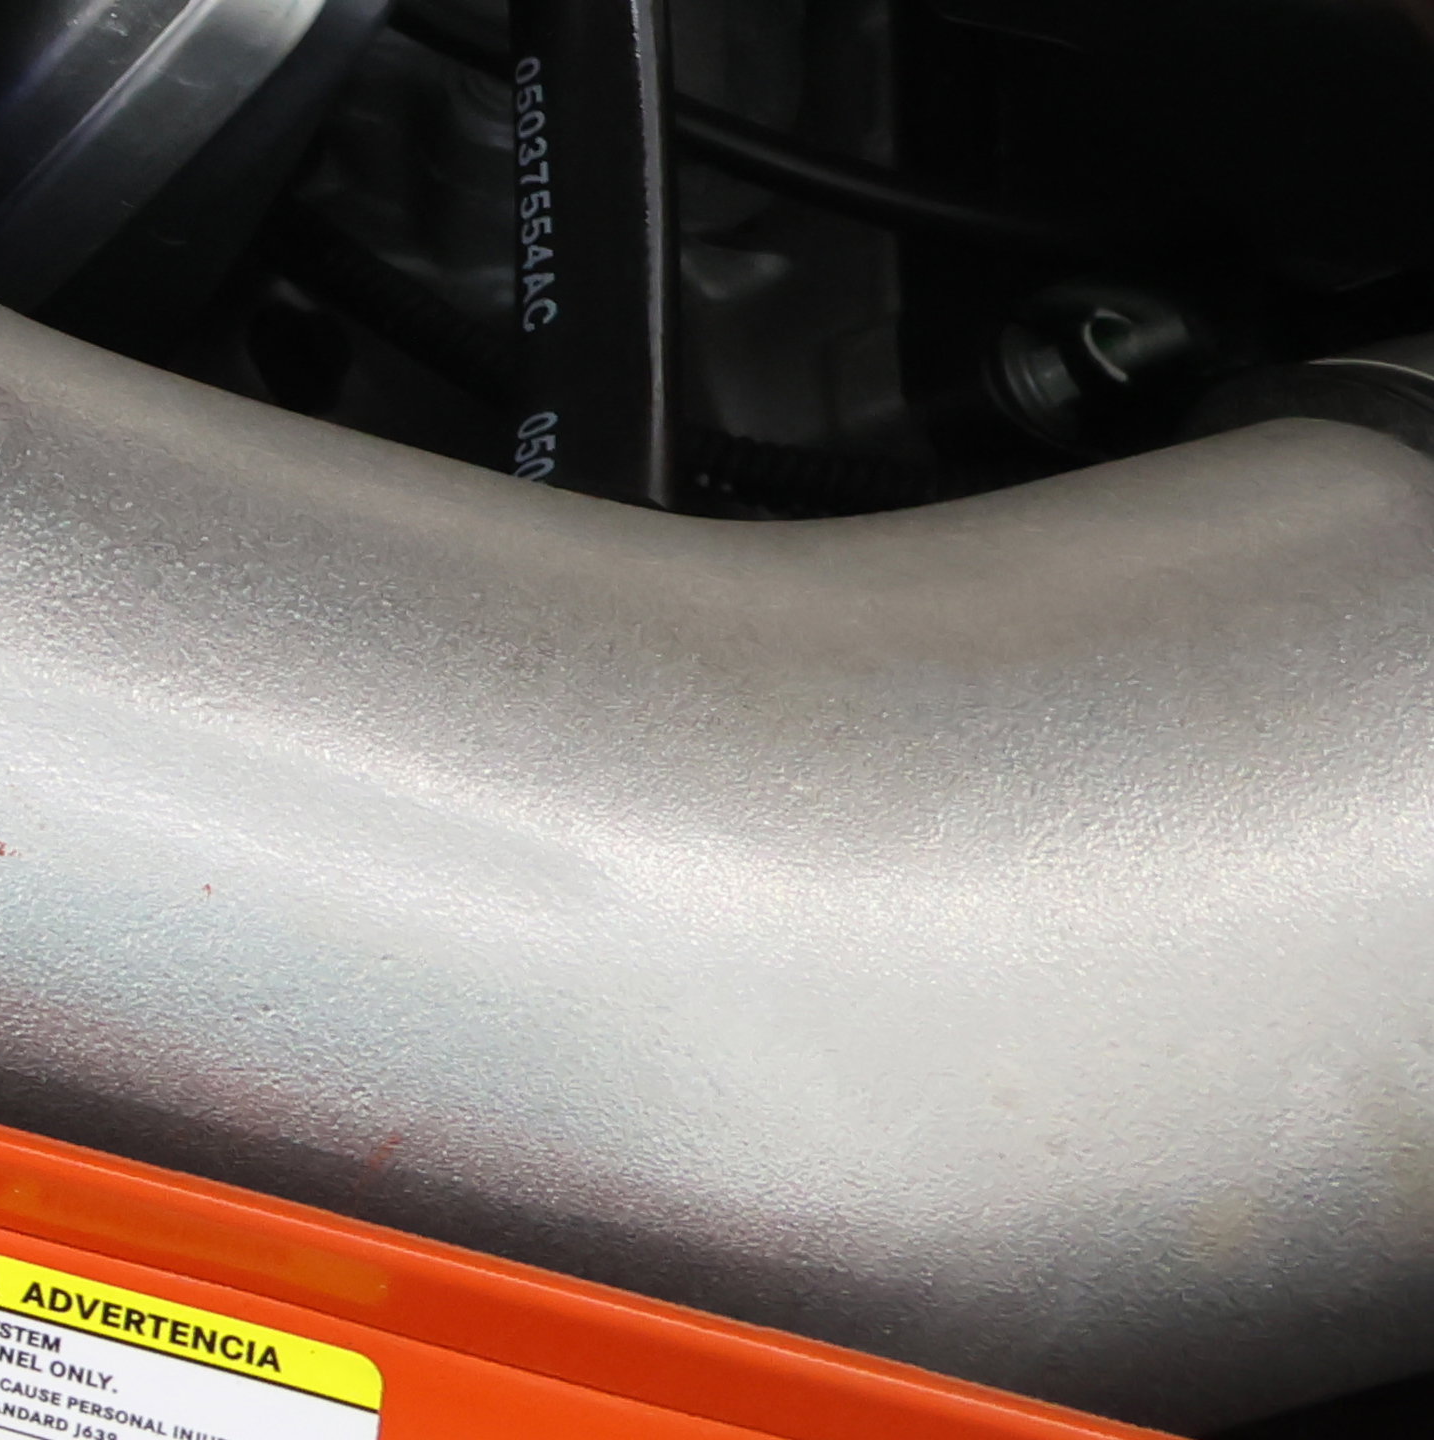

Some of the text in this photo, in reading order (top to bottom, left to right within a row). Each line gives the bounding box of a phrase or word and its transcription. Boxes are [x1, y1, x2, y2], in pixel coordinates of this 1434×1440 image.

[514, 56, 561, 333] 05037554AC
[21, 1281, 281, 1373] ADVERTENCIA
[0, 1377, 62, 1407] CAUSE
[66, 1396, 167, 1436] PERSONAL
[49, 1360, 117, 1393] ONLY.
